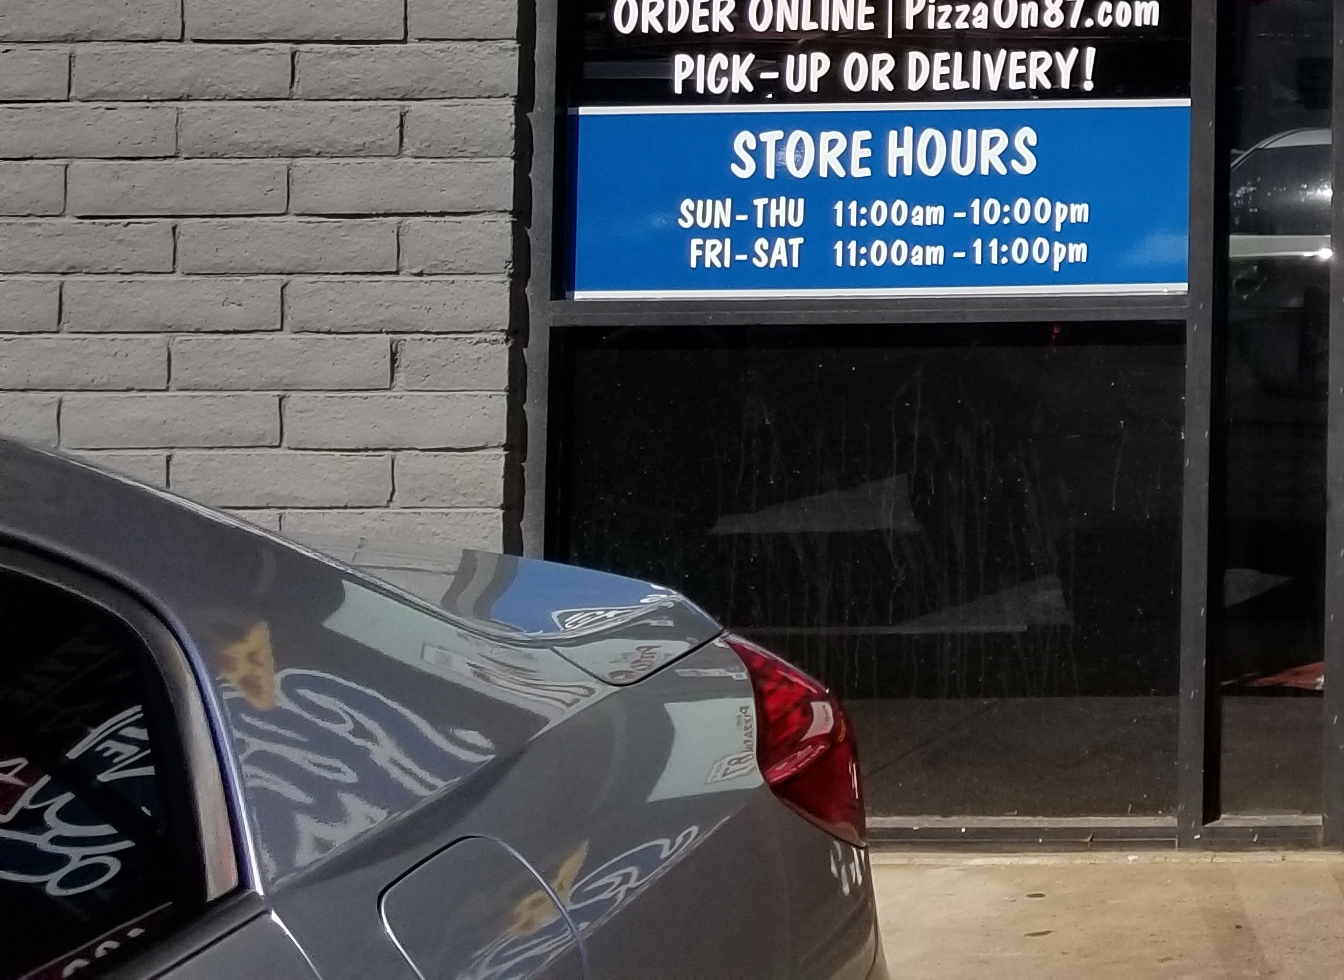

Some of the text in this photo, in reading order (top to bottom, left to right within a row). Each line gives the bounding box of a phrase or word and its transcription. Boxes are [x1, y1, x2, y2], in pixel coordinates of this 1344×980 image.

[673, 47, 1096, 95] PICK-UP OR DELIVERY!
[730, 126, 1038, 180] STORE HOURS
[677, 196, 806, 229] SUN-THU
[833, 199, 945, 227] 11:00am
[690, 237, 805, 269] FRI-SAT
[833, 239, 945, 267] 11:00am
